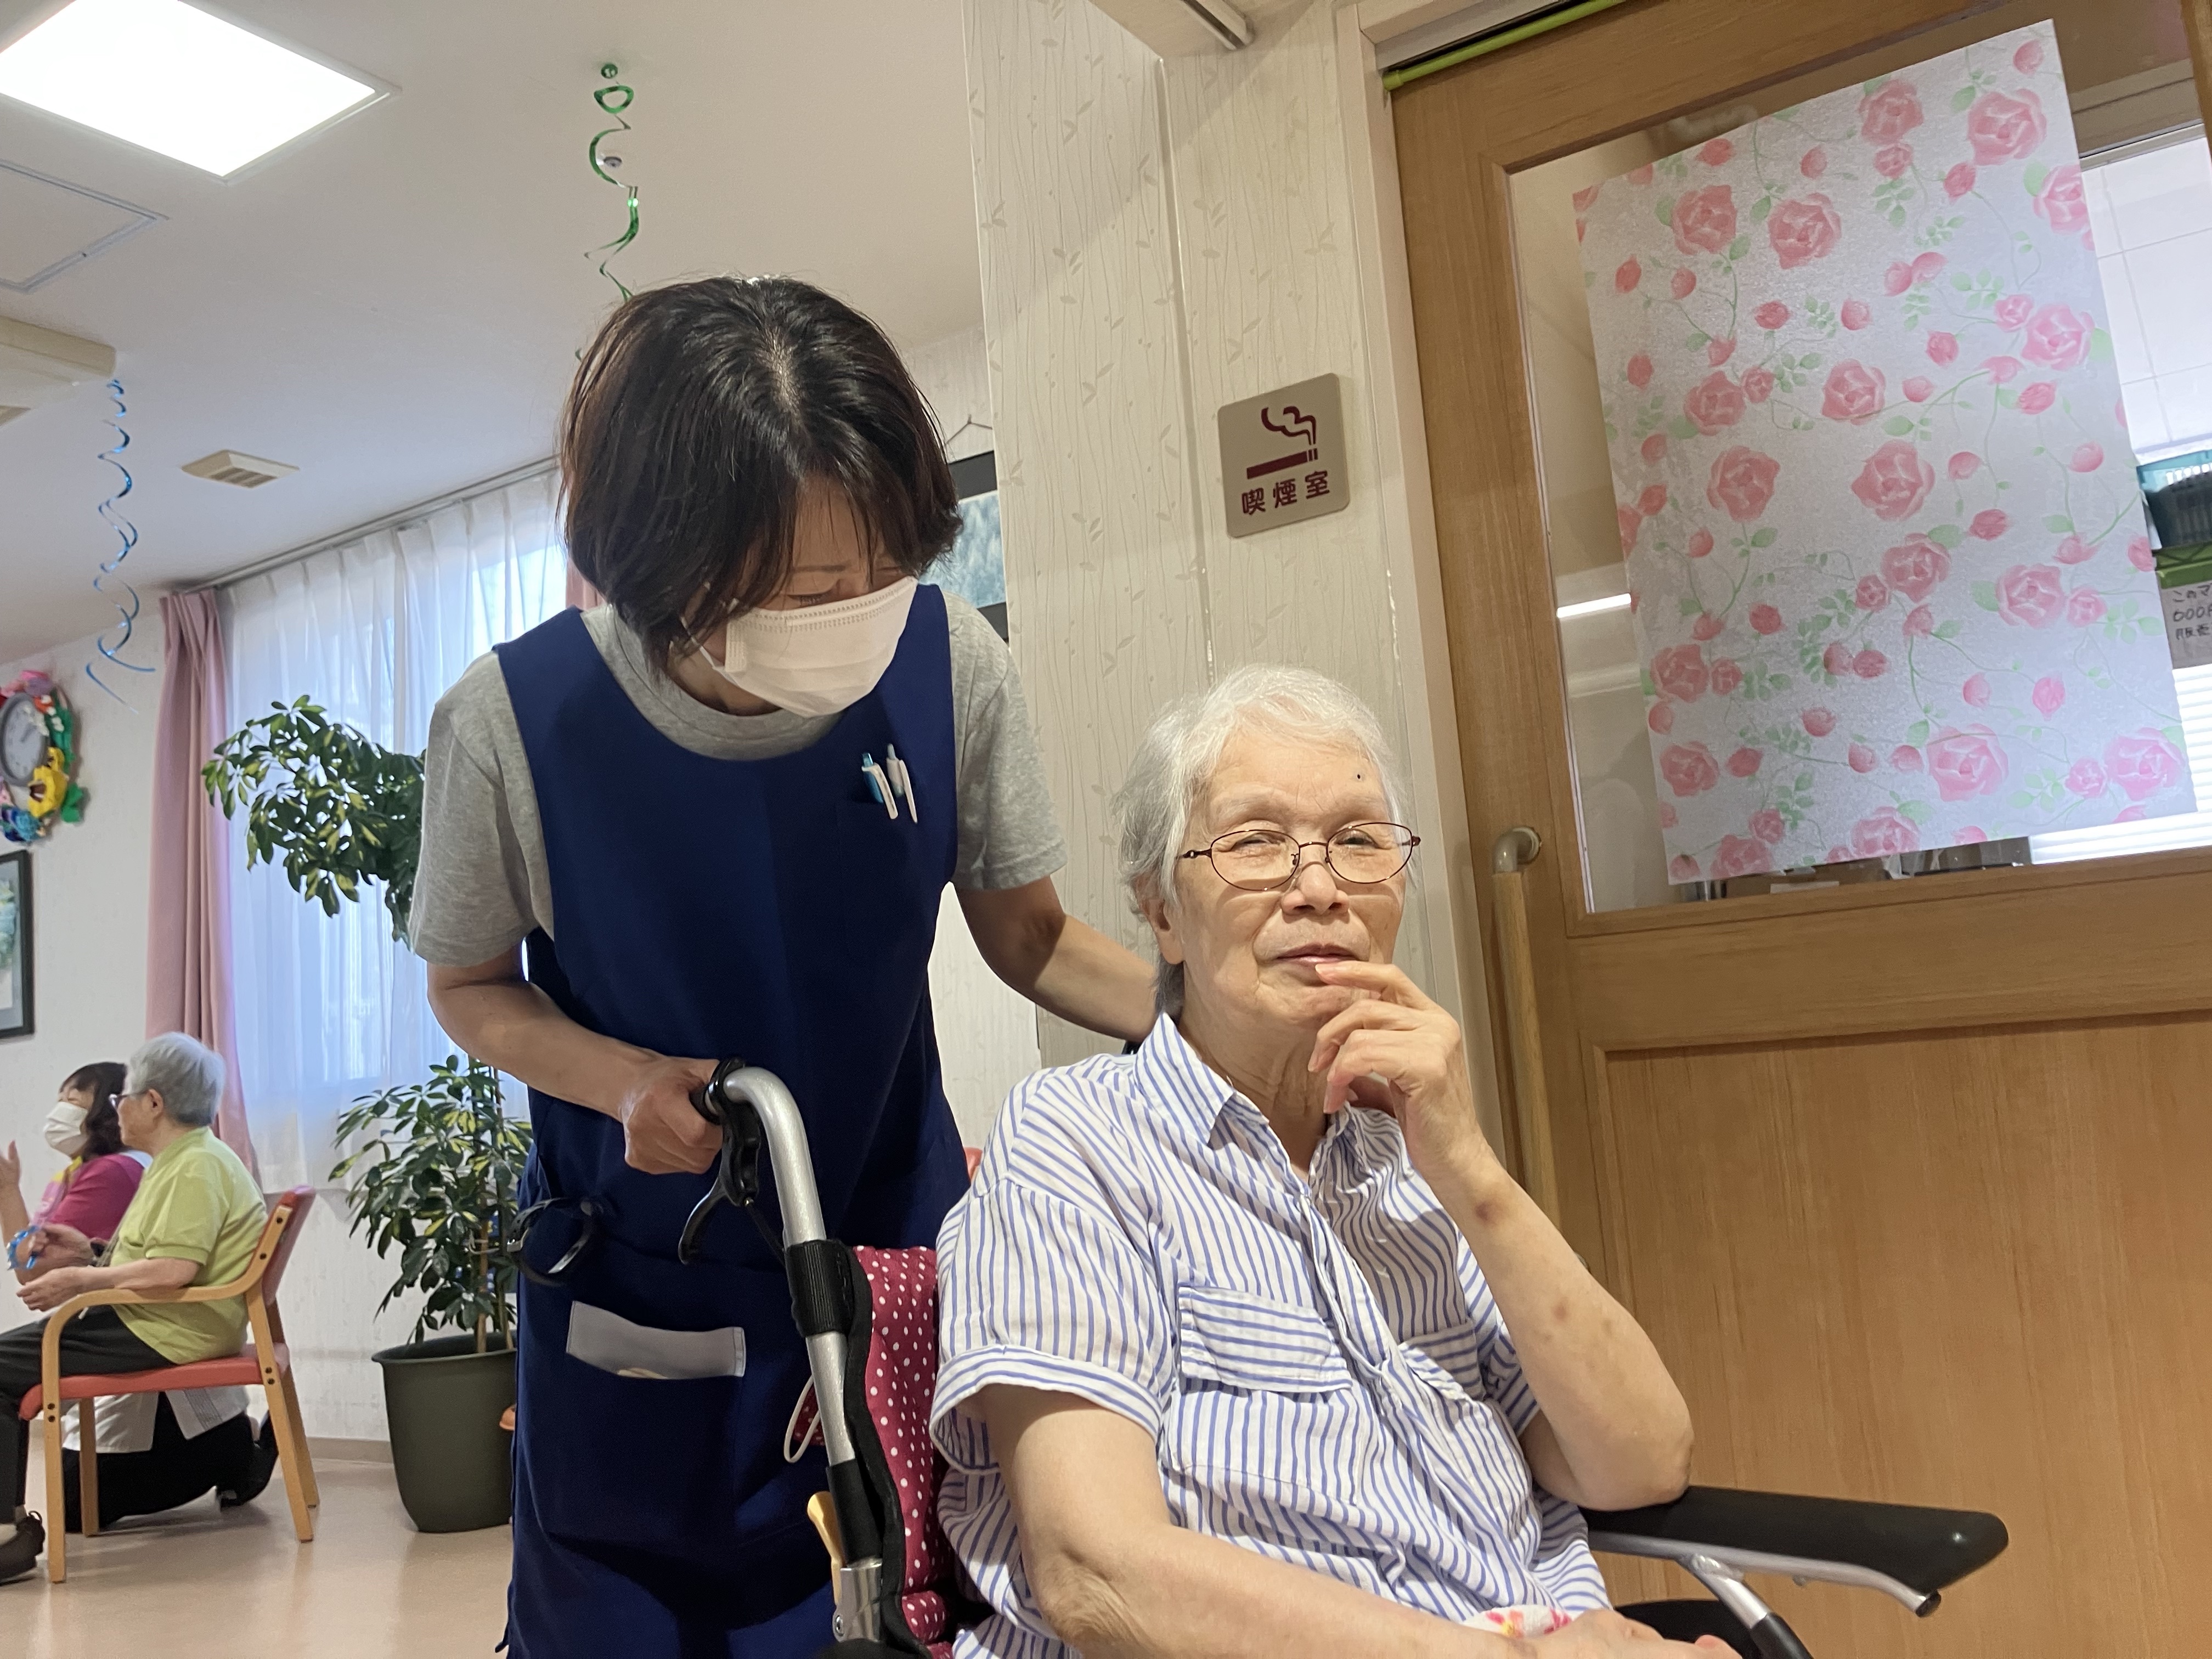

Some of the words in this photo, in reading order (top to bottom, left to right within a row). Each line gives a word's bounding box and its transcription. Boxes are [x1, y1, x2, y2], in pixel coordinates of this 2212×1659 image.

[1242, 470, 1330, 515] 喫煙室
[2172, 583, 2212, 602] このマ
